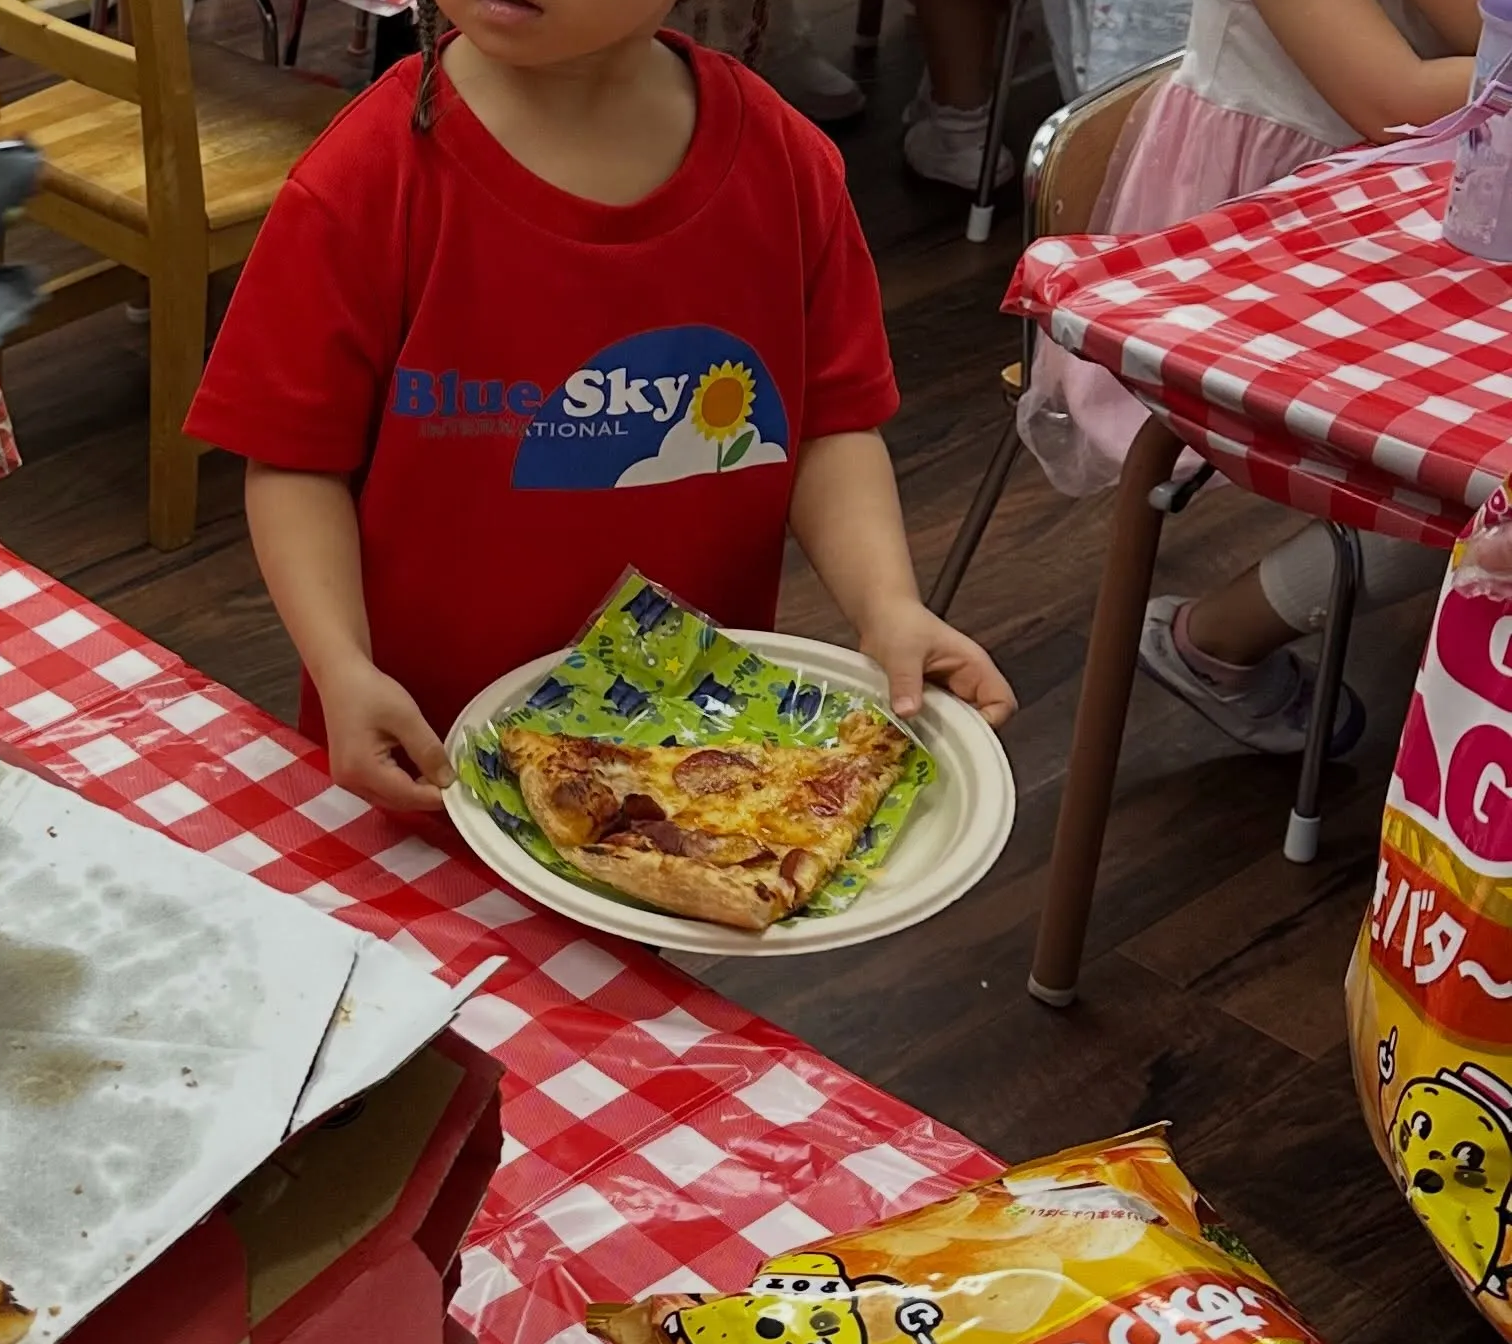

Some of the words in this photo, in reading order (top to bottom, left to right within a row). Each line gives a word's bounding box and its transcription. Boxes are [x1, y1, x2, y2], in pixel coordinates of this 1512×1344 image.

[392, 366, 543, 418] Blue
[562, 367, 689, 422] Sky
[420, 418, 629, 439] INTERNATIONAL
[766, 1277, 841, 1294] POT
